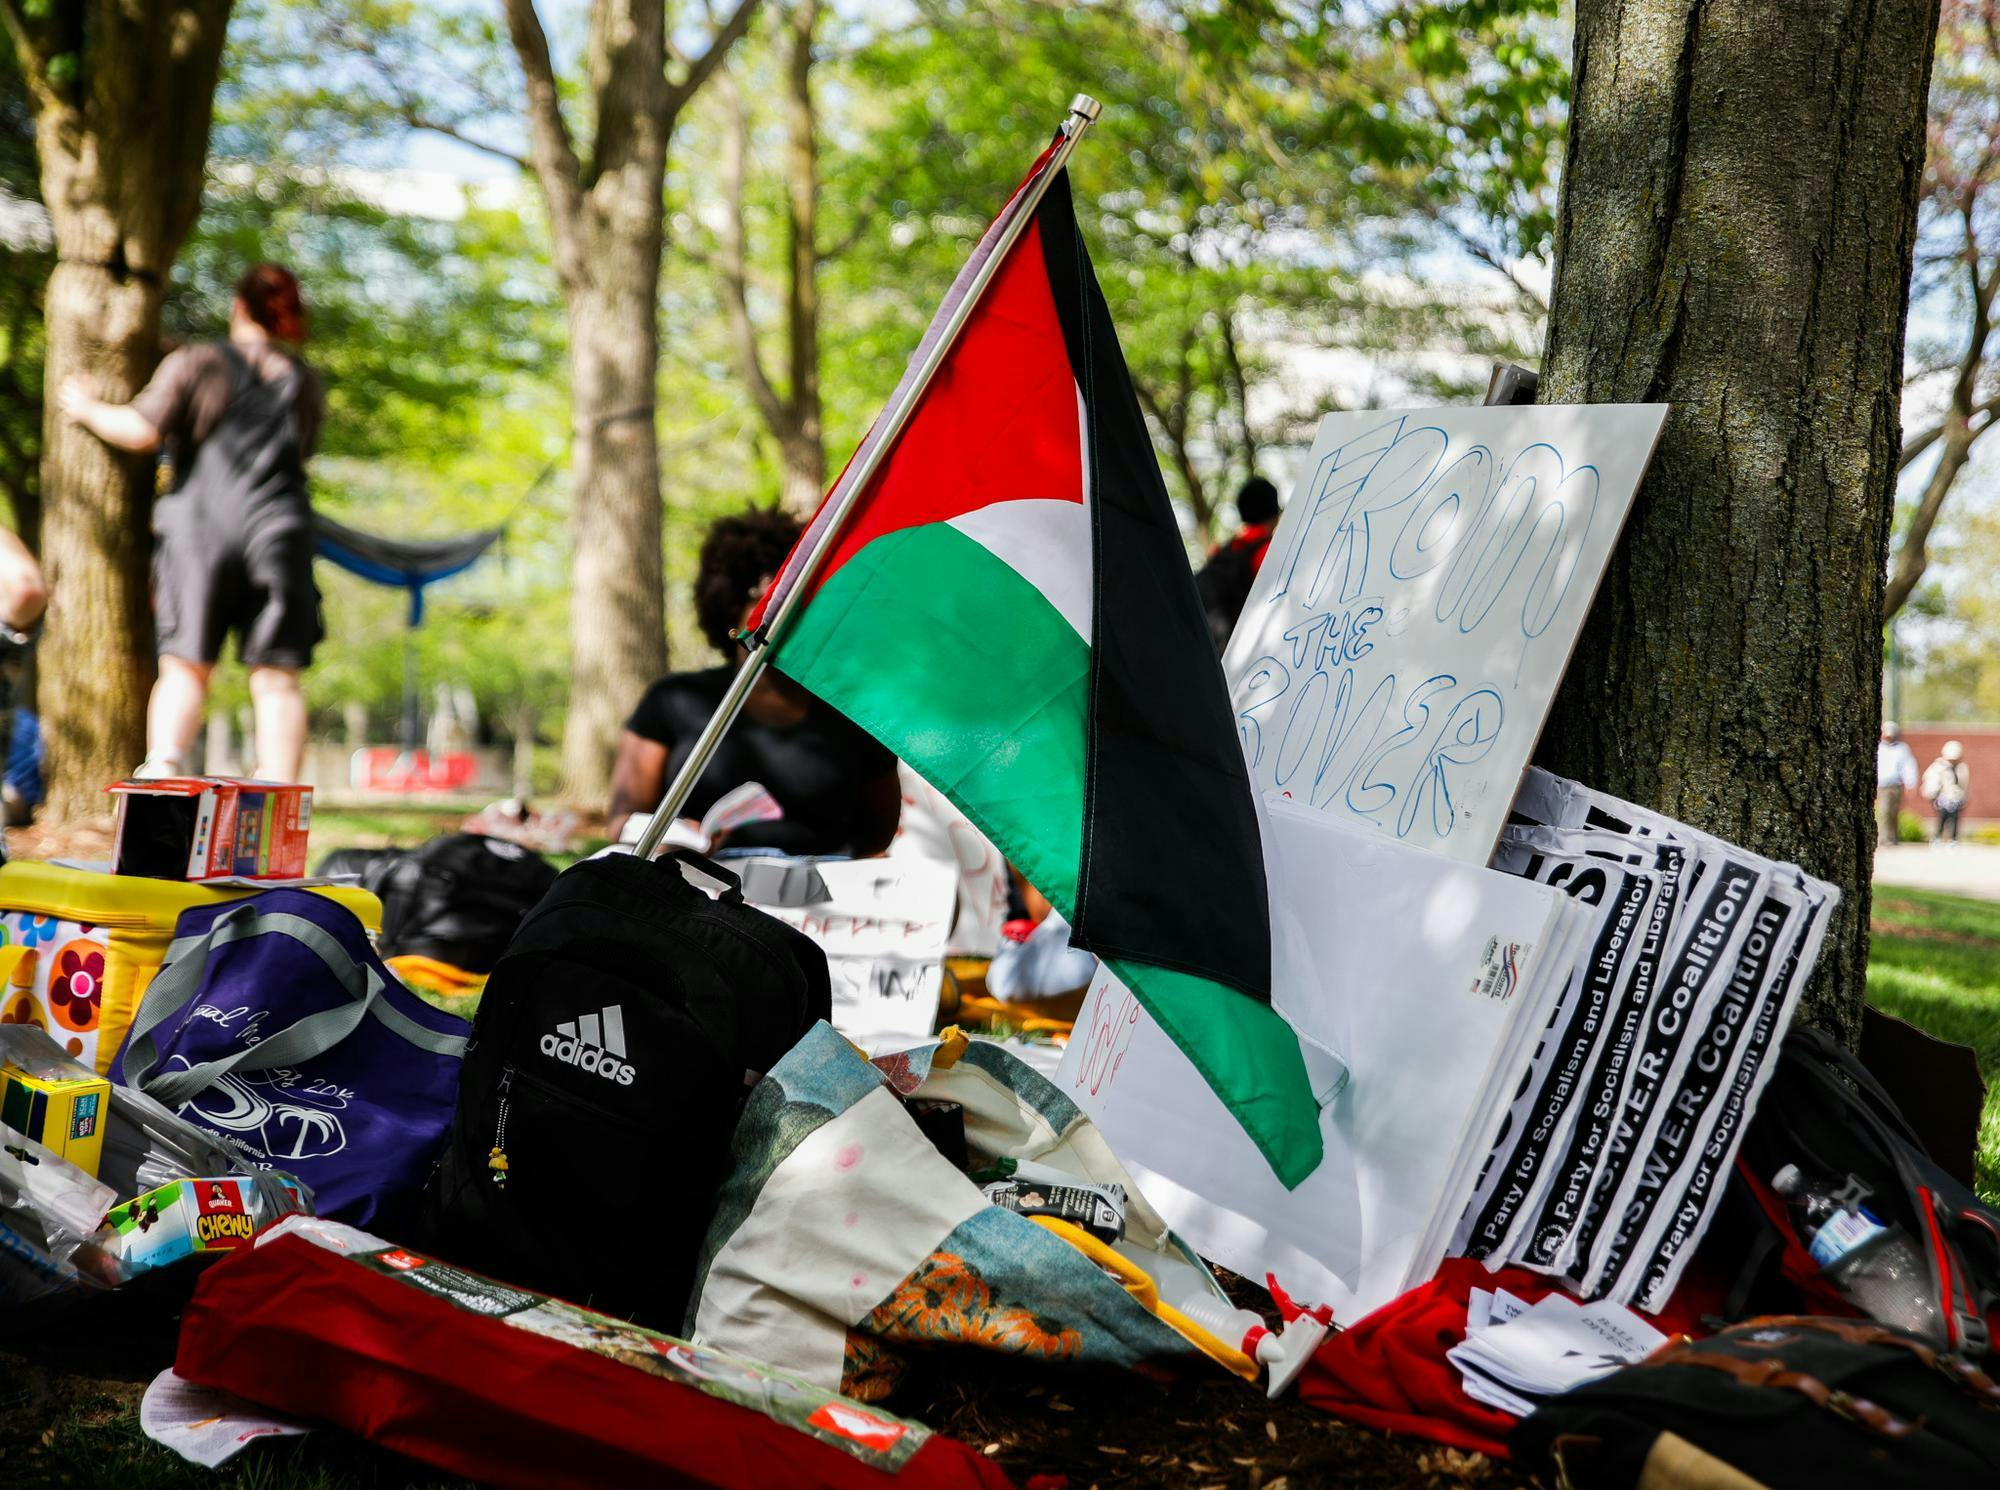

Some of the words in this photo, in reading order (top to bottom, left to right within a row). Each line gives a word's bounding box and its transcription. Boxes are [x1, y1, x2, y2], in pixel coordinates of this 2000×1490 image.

[1269, 415, 1601, 638] FROM
[1283, 606, 1384, 671] THE
[1642, 849, 1685, 955] Liberatio
[1632, 961, 1651, 1004] and
[1656, 875, 1750, 1037] Coalition
[1697, 908, 1781, 1075] Coalition
[540, 1034, 636, 1086] adidas
[1484, 1182, 1524, 1241] Party
[1516, 1147, 1537, 1180] for
[1533, 1039, 1589, 1142] Socialism
[1583, 989, 1605, 1032] and
[1595, 874, 1647, 985] Liberation
[1592, 1010, 1638, 1117] Socialism
[224, 1133, 266, 1160] California
[1582, 1123, 1603, 1155] for
[1659, 1197, 1701, 1268] Party
[1691, 1161, 1711, 1196] for
[1704, 1047, 1759, 1157] Socialism
[1752, 1001, 1775, 1043] and
[208, 1199, 232, 1208] QUAKER
[1554, 1160, 1592, 1219] Party
